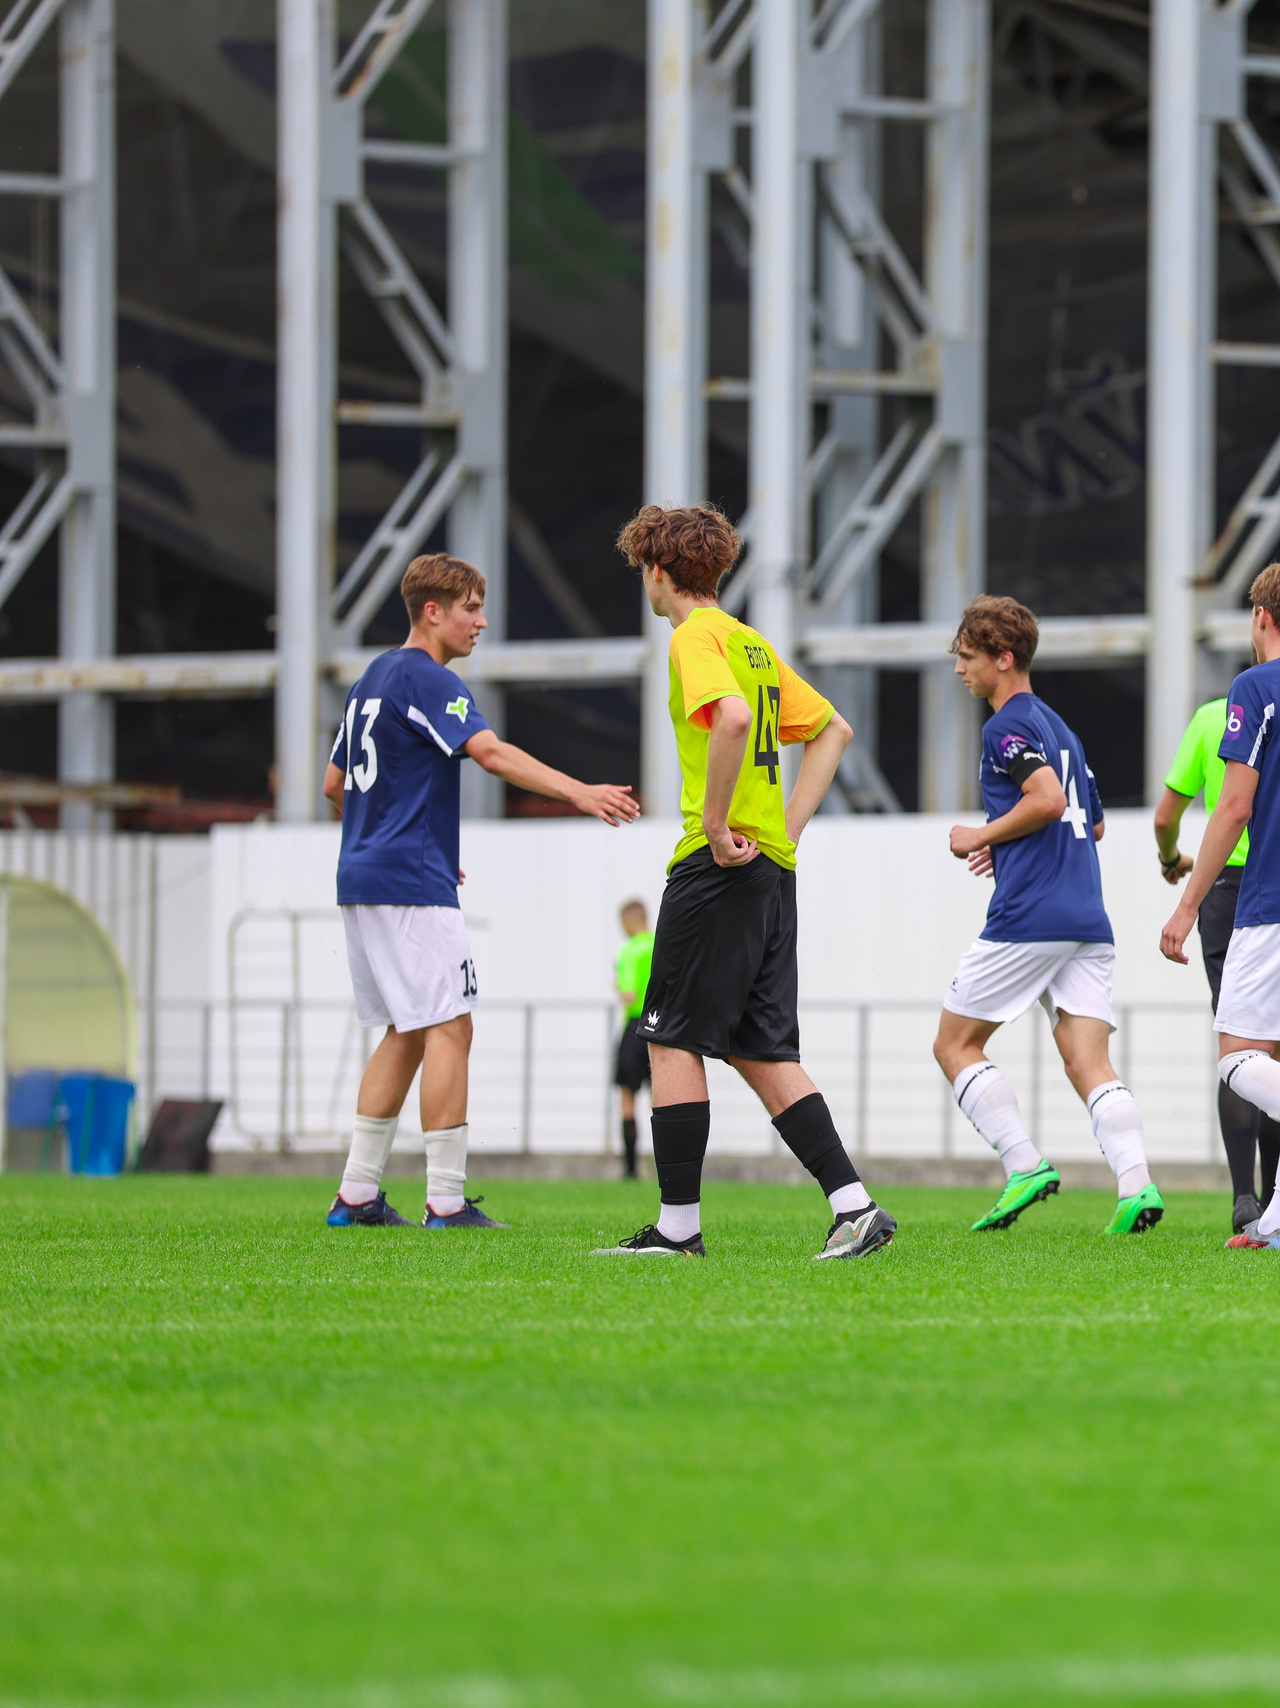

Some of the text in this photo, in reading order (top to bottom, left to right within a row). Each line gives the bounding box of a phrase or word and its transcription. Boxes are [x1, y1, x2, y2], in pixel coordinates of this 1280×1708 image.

[343, 697, 382, 794] 13
[754, 684, 780, 785] 47
[1060, 749, 1088, 839] 4
